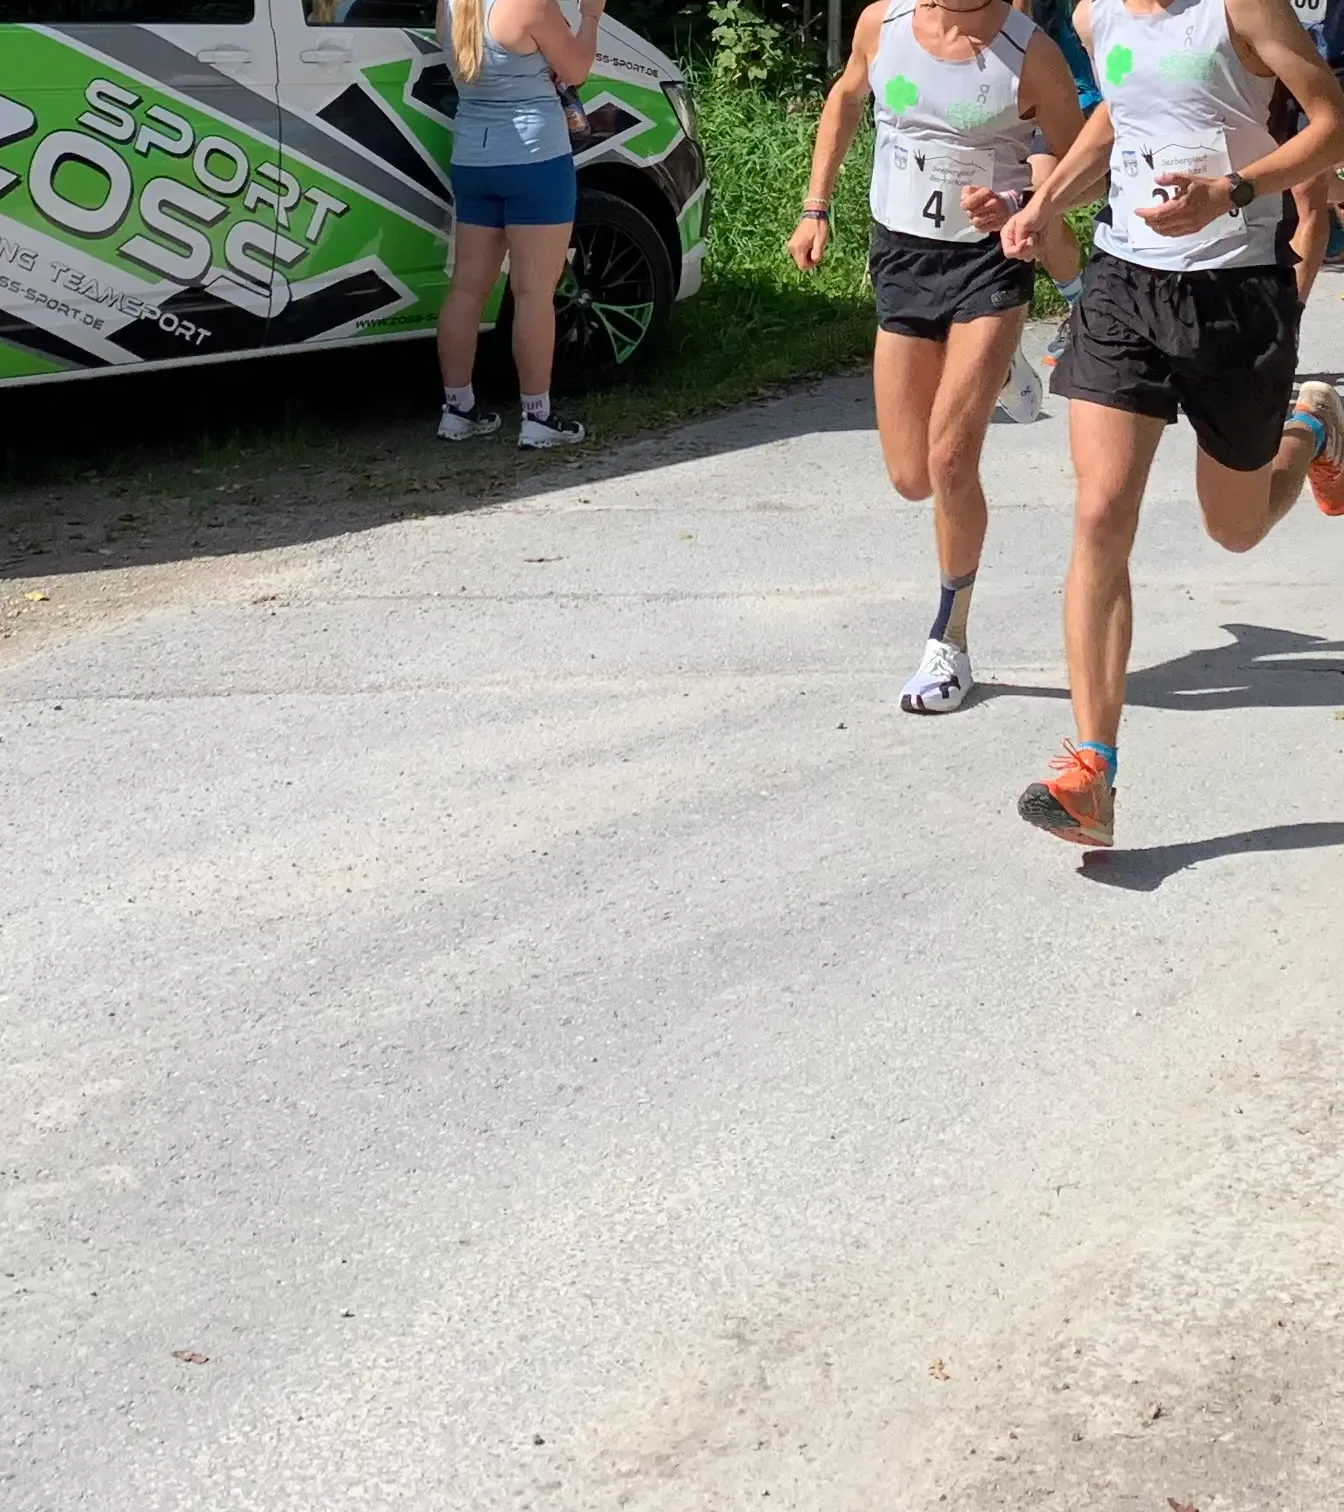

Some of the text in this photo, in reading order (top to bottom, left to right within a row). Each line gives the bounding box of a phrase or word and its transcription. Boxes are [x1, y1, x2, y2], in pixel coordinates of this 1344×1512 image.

[593, 52, 659, 78] SS-SPORT.DE
[75, 78, 350, 245] SPORT
[922, 189, 946, 228] 4
[50, 261, 213, 346] TEAMSPORT
[355, 312, 439, 329] WWW.ZOSS-S
